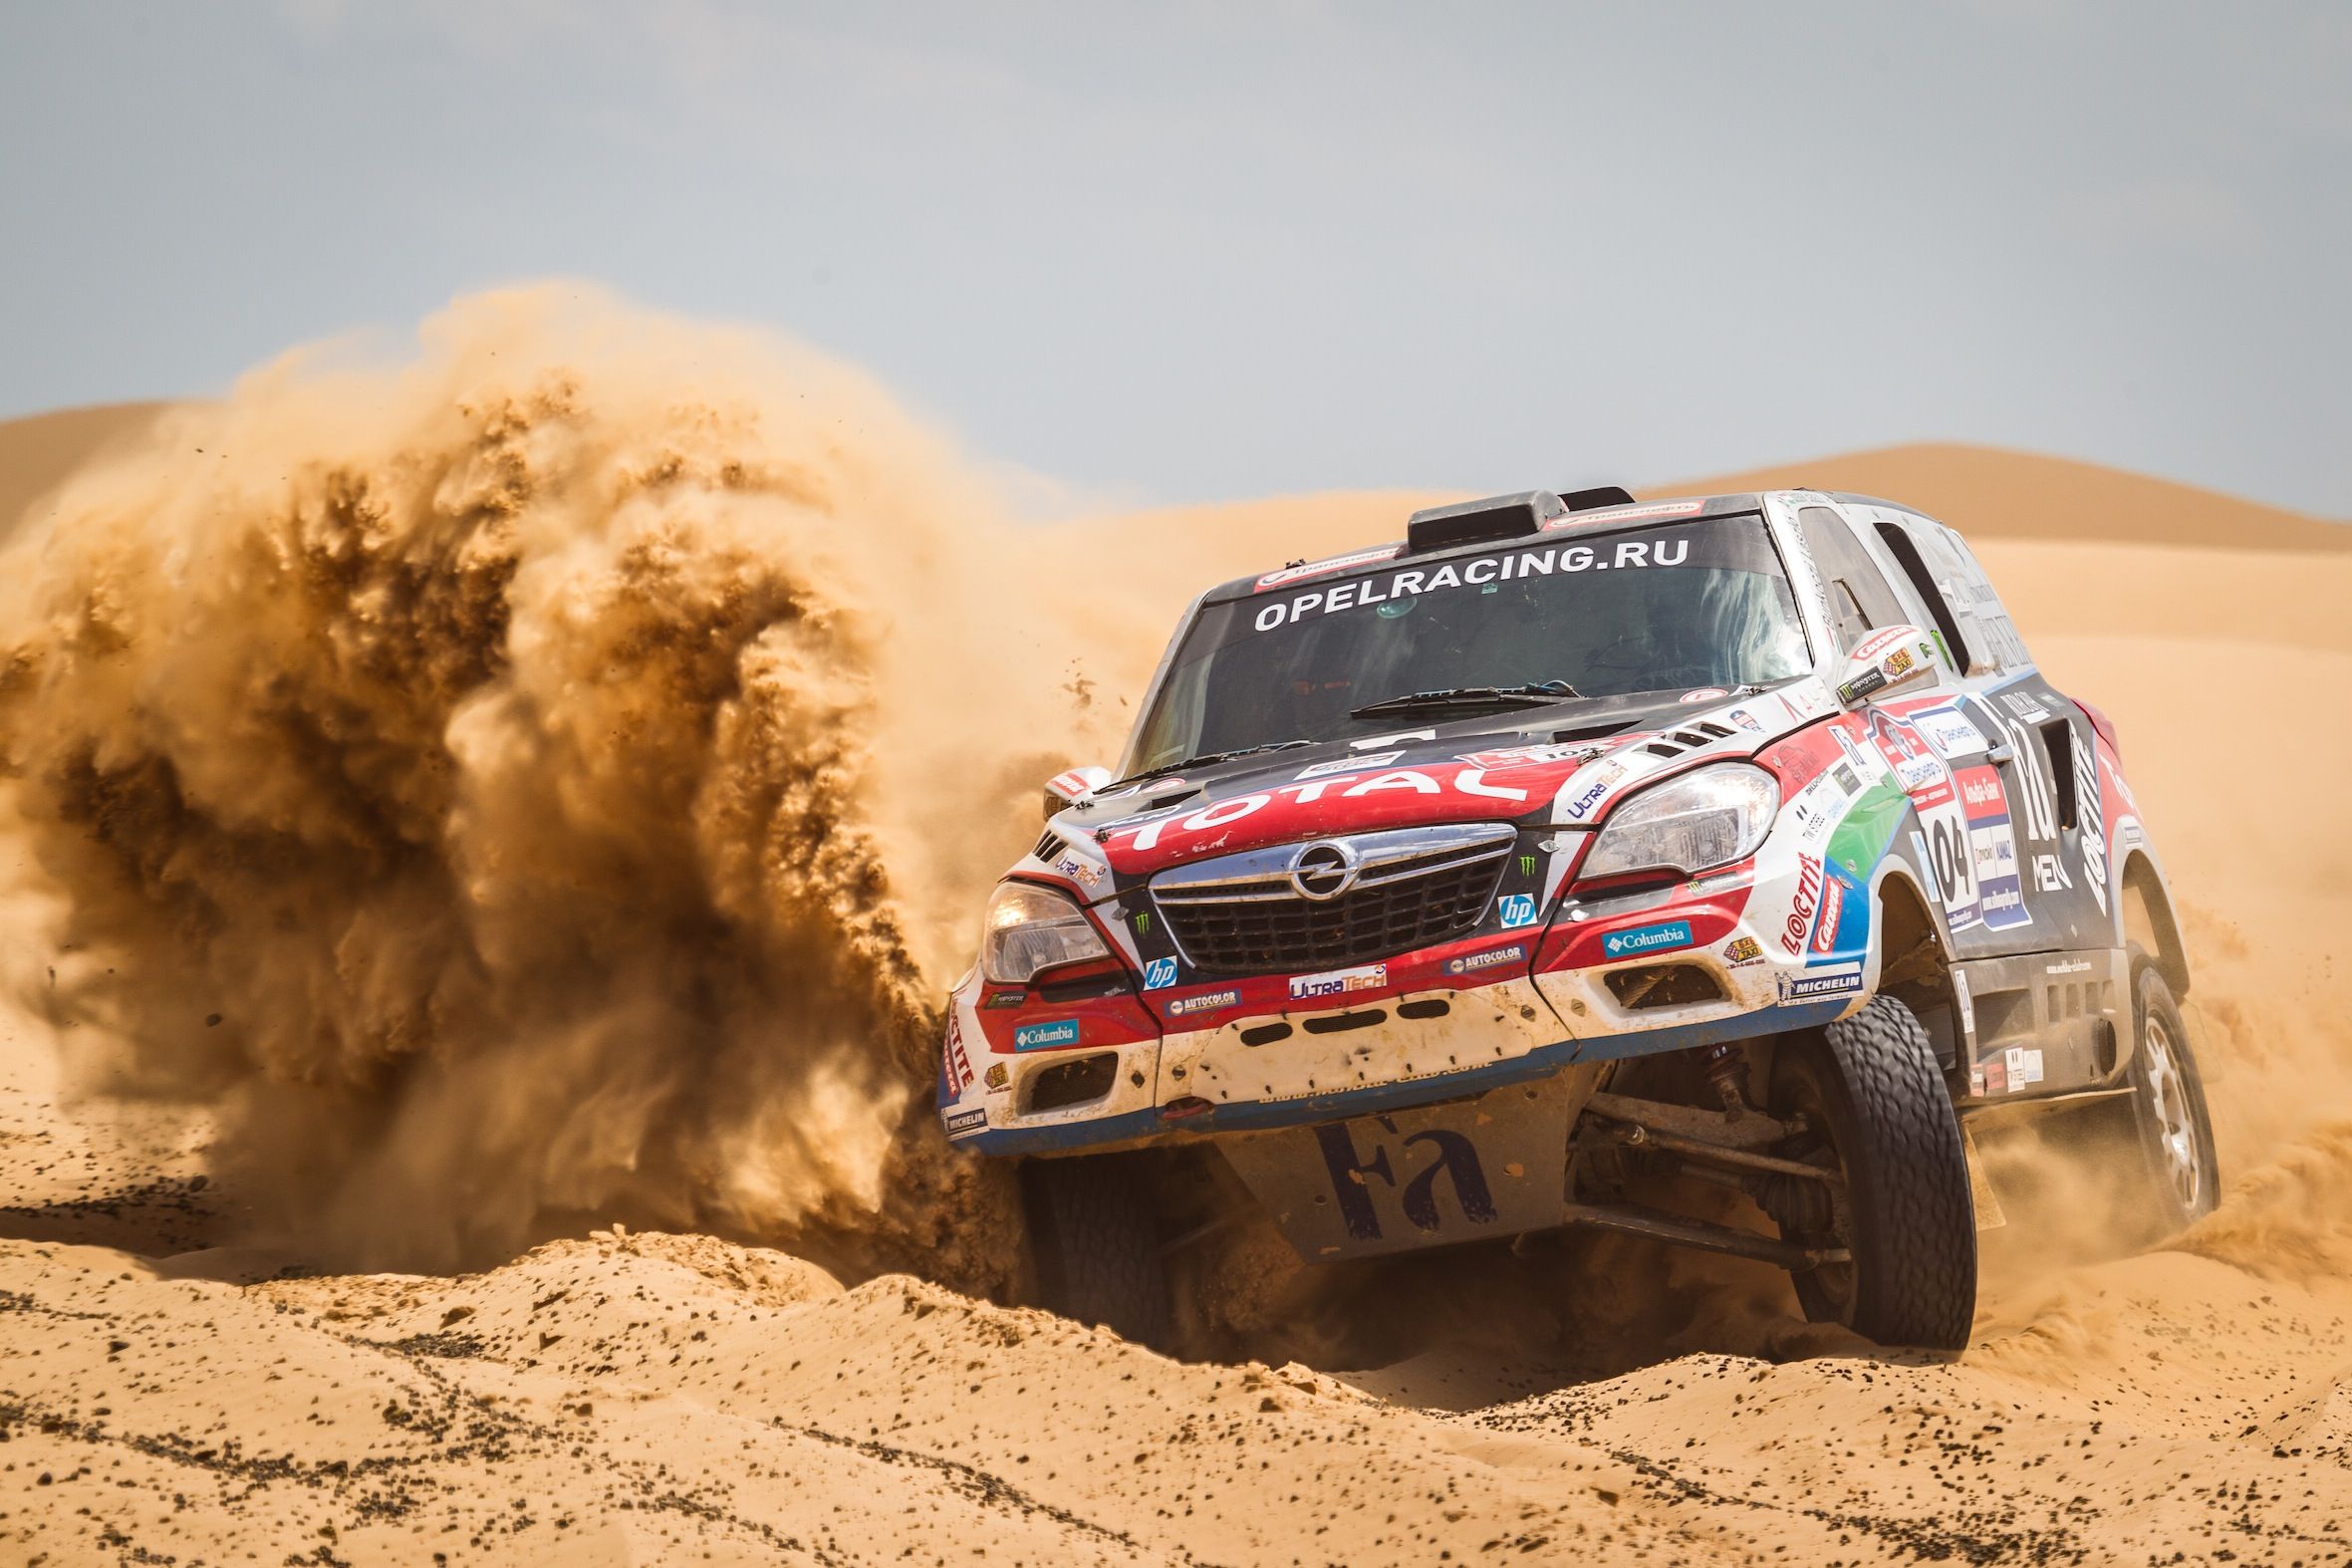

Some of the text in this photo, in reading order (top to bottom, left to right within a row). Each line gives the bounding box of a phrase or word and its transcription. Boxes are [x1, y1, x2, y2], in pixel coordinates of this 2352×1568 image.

[1254, 539, 1690, 632] OPELRACING.RU
[1897, 658, 1913, 671] TAXI
[1850, 672, 1880, 690] MONSTER
[1113, 769, 1527, 851] TOTAL
[2068, 717, 2107, 917] LOCTITE
[2032, 854, 2073, 892] MEN
[1503, 895, 1531, 926] hp
[1781, 852, 1821, 956] LOCTITE
[1622, 927, 1685, 949] Columbia
[1465, 947, 1521, 967] AUTOCOLOR
[1150, 957, 1174, 987] hp
[1796, 976, 1860, 994] MICHELIN
[1184, 991, 1235, 1009] AUTOCOLOR
[1027, 1026, 1073, 1044] Columbia
[949, 1113, 985, 1132] MICHELIN
